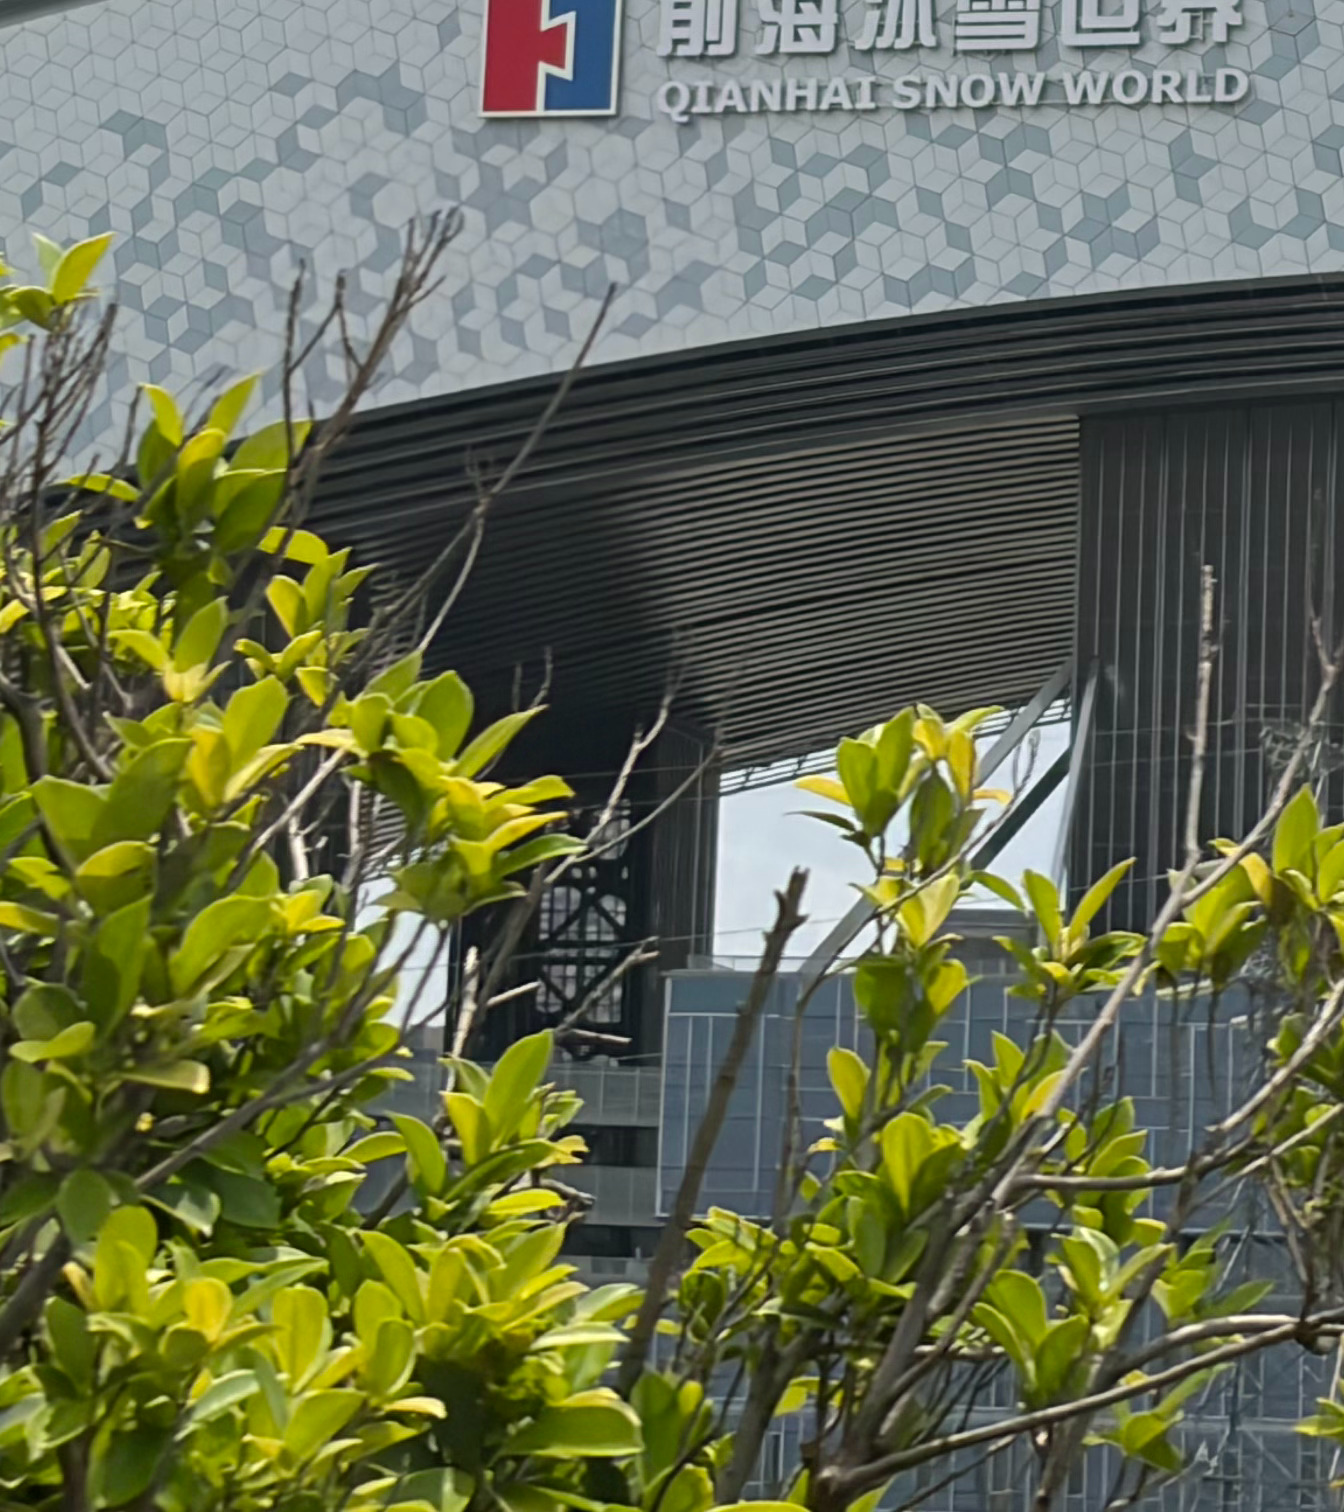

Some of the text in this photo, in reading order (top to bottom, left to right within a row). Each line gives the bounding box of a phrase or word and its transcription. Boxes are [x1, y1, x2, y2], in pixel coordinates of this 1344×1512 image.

[657, 67, 1250, 123] QIANHAI SNOW WORLD
